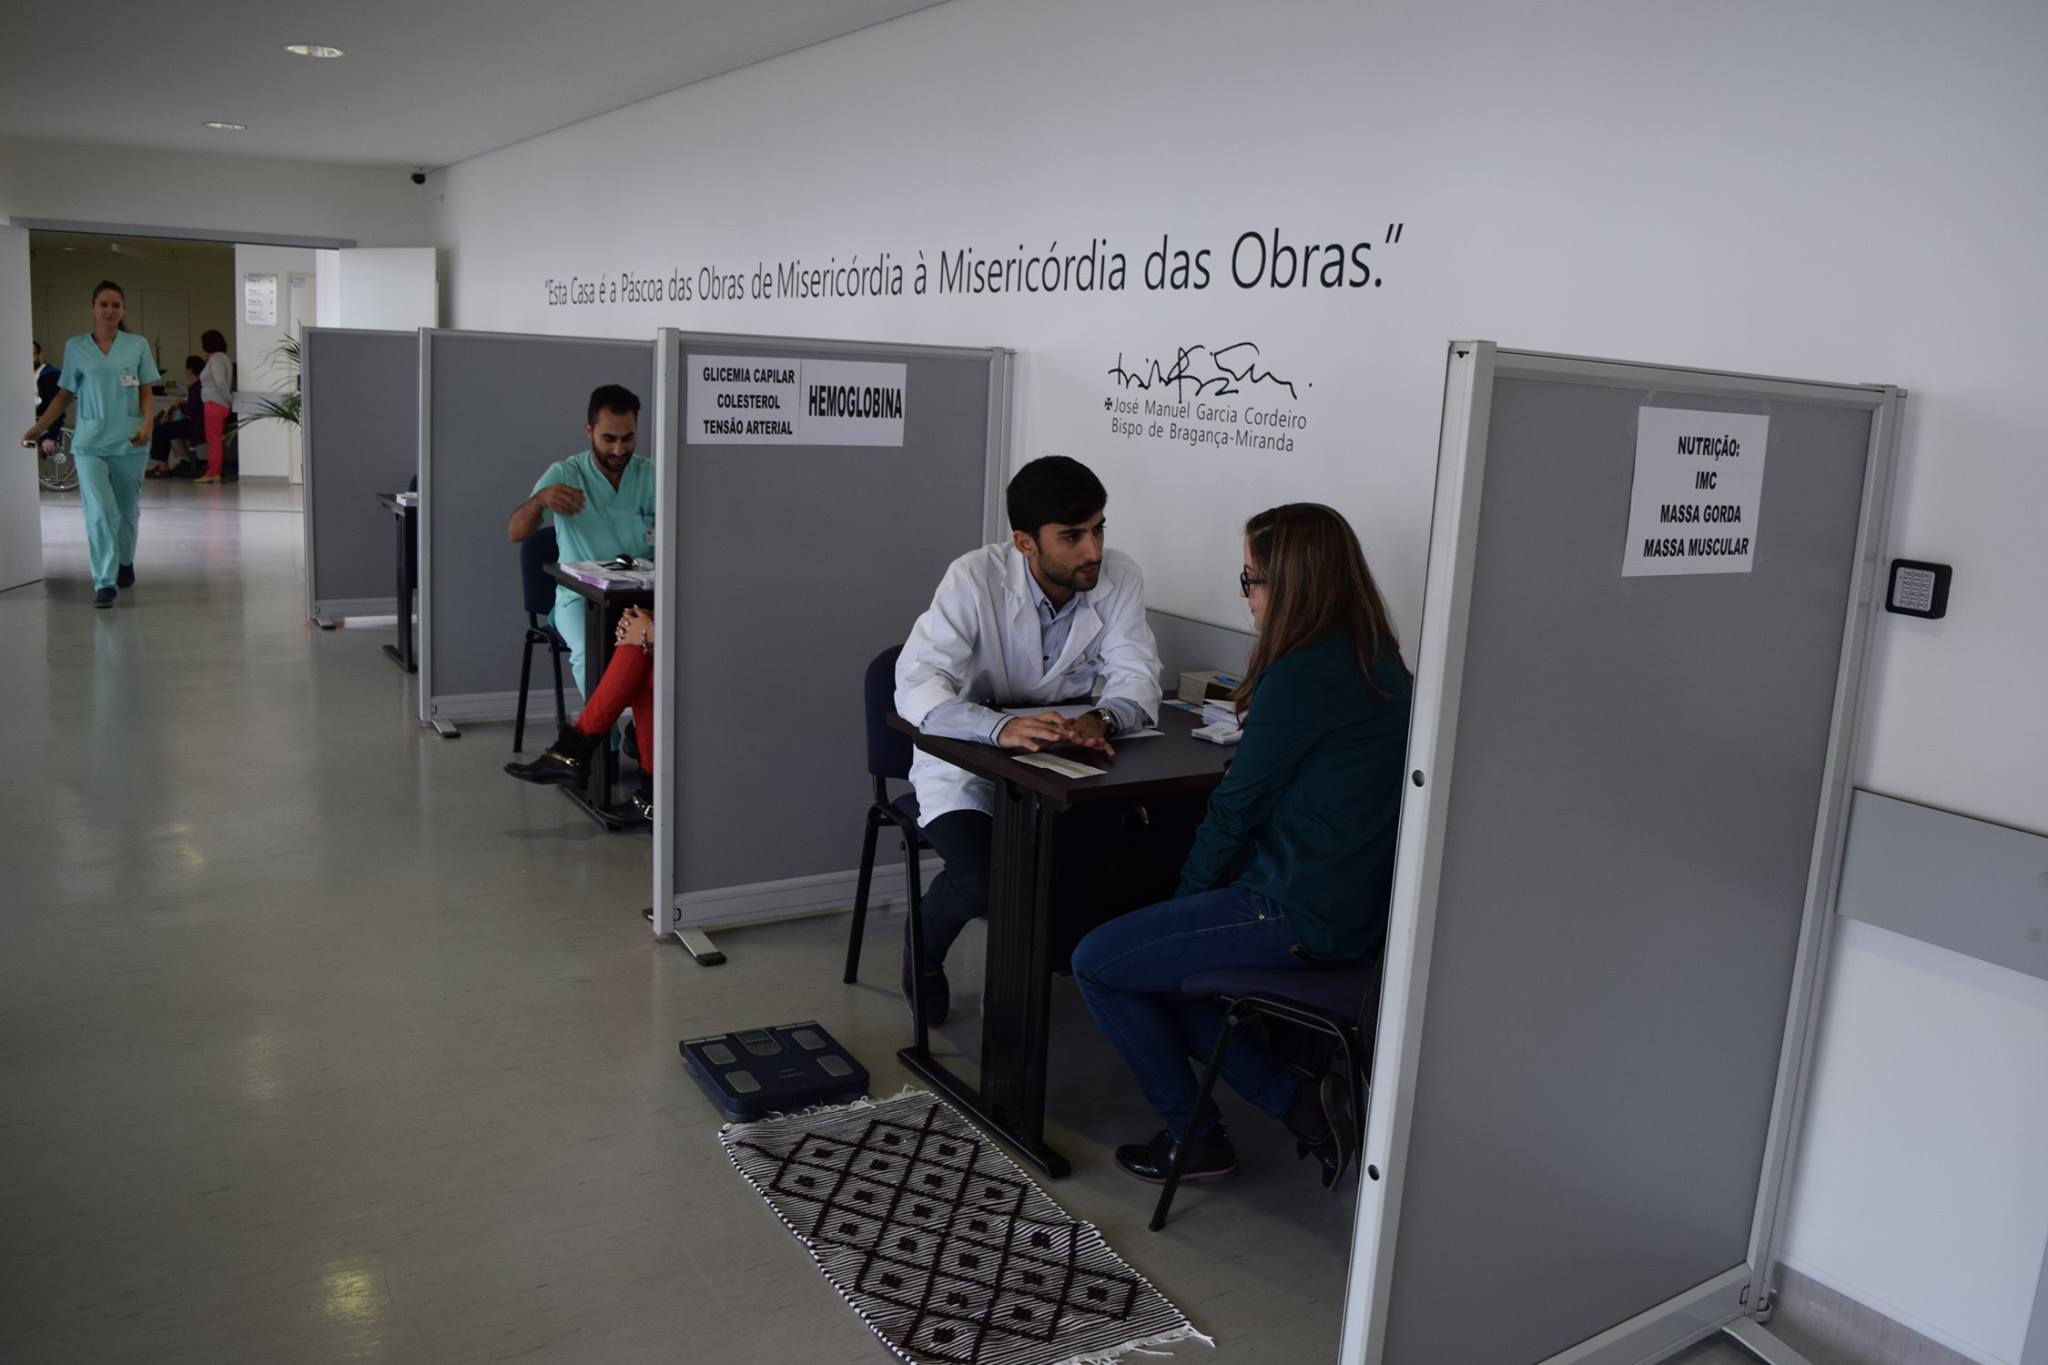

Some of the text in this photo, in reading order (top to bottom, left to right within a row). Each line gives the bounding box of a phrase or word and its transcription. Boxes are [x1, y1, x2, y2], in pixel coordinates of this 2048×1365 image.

[570, 275, 595, 305] Casa
[598, 273, 607, 304] é
[609, 281, 617, 304] a
[621, 270, 663, 303] Páscoa
[668, 267, 693, 302] das
[698, 265, 745, 301] Obras
[751, 261, 773, 300] de
[777, 252, 903, 299] Misericórdia
[913, 250, 927, 295] à
[939, 238, 1127, 294] Misericórdia
[1144, 233, 1211, 291] das
[1231, 222, 1404, 290] Obras."
[702, 366, 795, 384] GLICEMIA CAPILAR
[716, 393, 781, 410] COLESTEROL
[808, 384, 903, 419] HEMOGLOBINA
[1113, 397, 1307, 430] José Manuel Garcia Cordeiro
[703, 416, 793, 435] TENSÃO ARTERIAL
[1111, 417, 1295, 452] Bispo de Bragança-Miranda
[1677, 434, 1741, 462] NUTRIÇÃO:
[1695, 471, 1718, 490] IMC
[1659, 504, 1742, 524] MASSA GORDA
[1642, 537, 1750, 558] MASSA MUSCULAR
